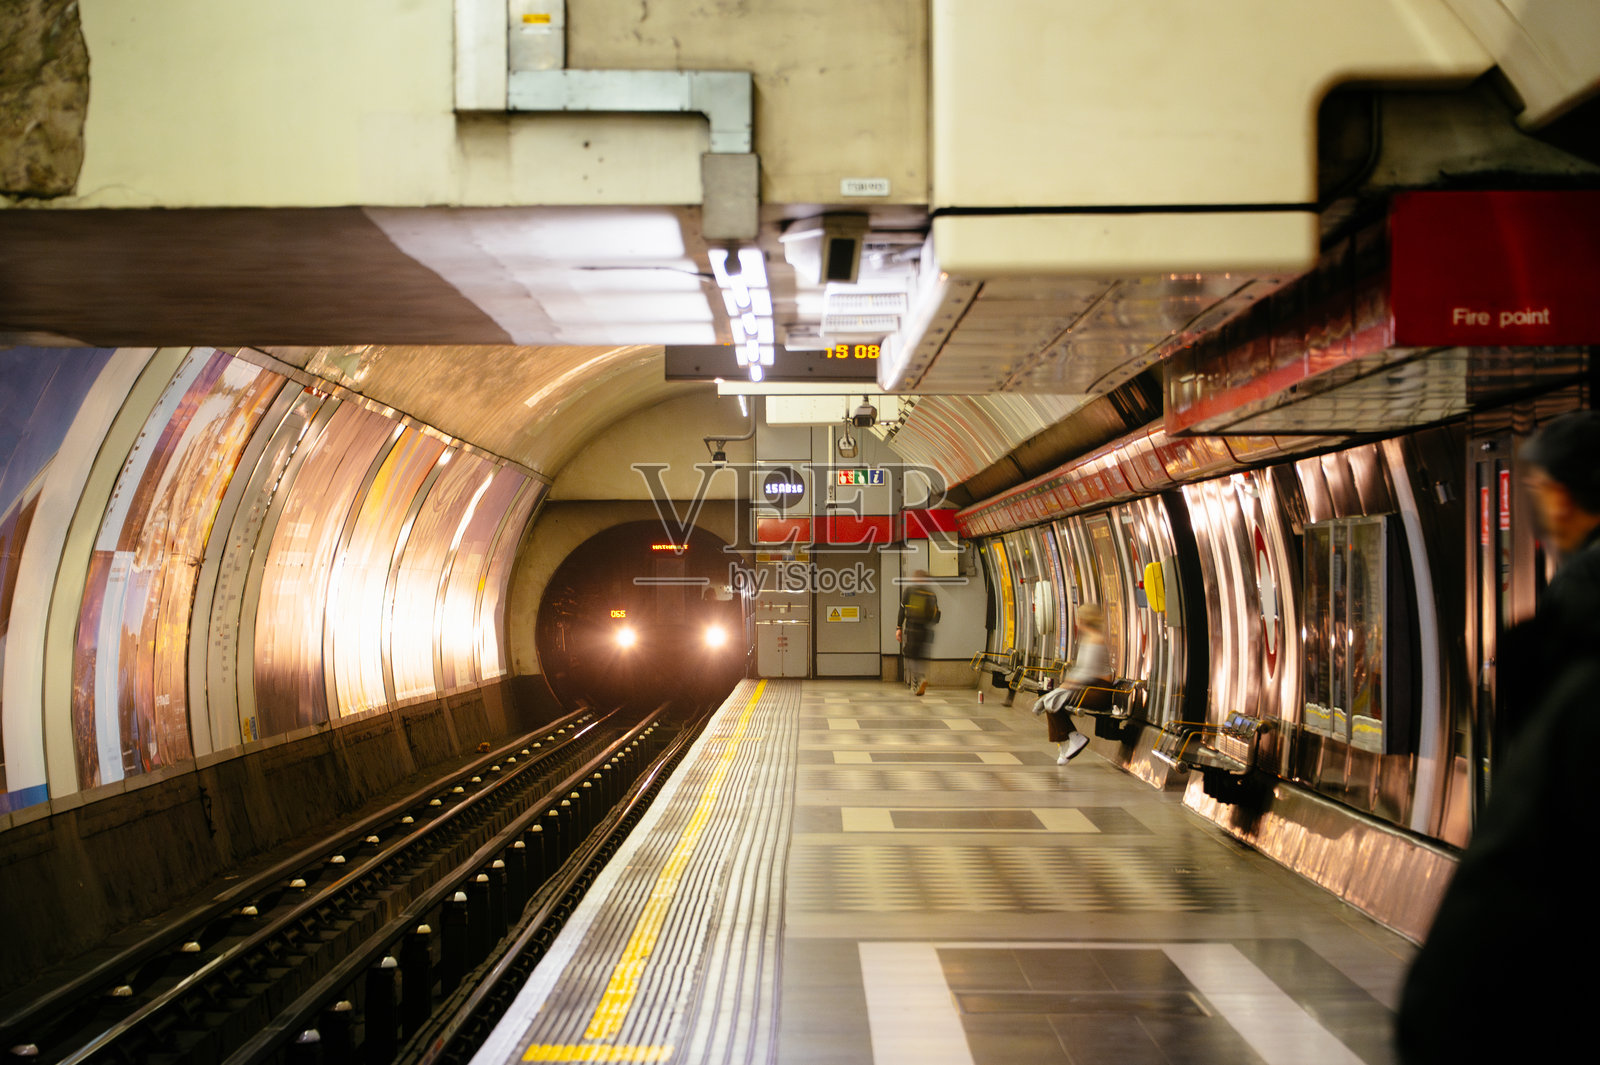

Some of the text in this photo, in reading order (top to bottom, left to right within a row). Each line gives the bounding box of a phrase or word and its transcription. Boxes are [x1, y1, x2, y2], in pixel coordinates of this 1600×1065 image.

[1453, 307, 1550, 328] Fire point
[824, 344, 880, 359] 15 08
